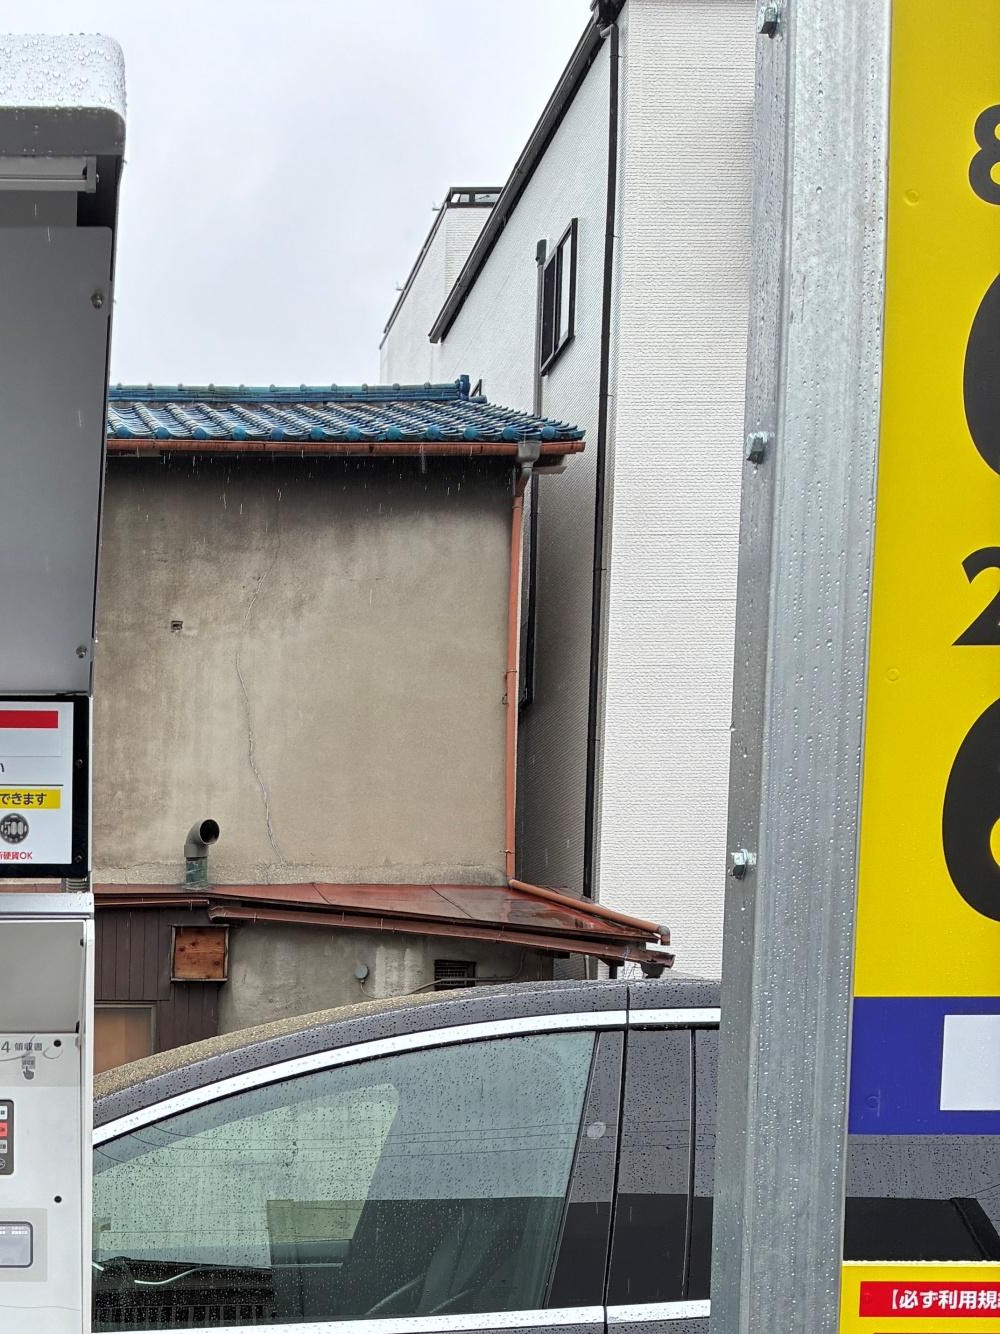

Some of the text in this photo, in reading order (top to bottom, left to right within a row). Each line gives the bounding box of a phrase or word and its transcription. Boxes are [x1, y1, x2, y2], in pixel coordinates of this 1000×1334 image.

[1, 1041, 11, 1053] 4
[892, 1289, 1000, 1310] 【必ず利用規
